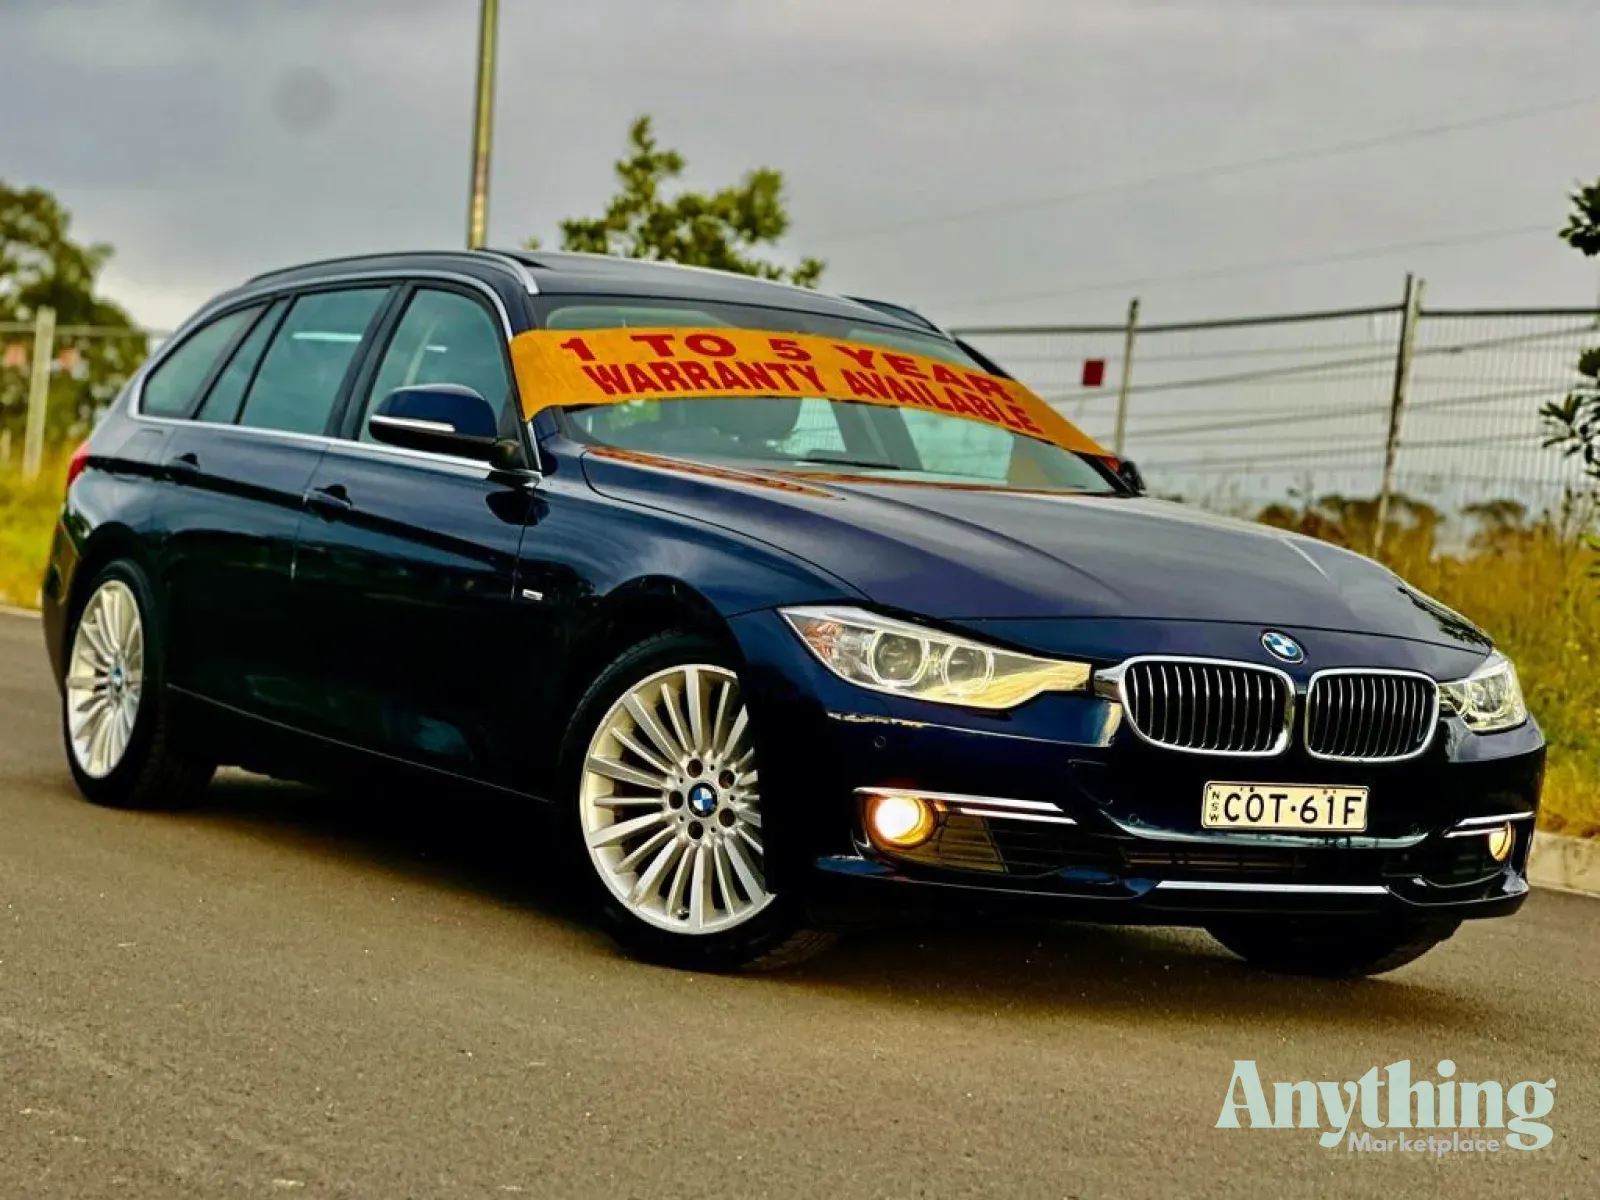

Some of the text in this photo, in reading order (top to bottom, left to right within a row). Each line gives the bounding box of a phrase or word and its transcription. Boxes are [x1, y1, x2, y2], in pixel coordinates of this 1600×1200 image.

[560, 333, 1014, 402] 1 TO 5 YEAR
[581, 360, 1045, 434] WARRANTY AVAILABLE
